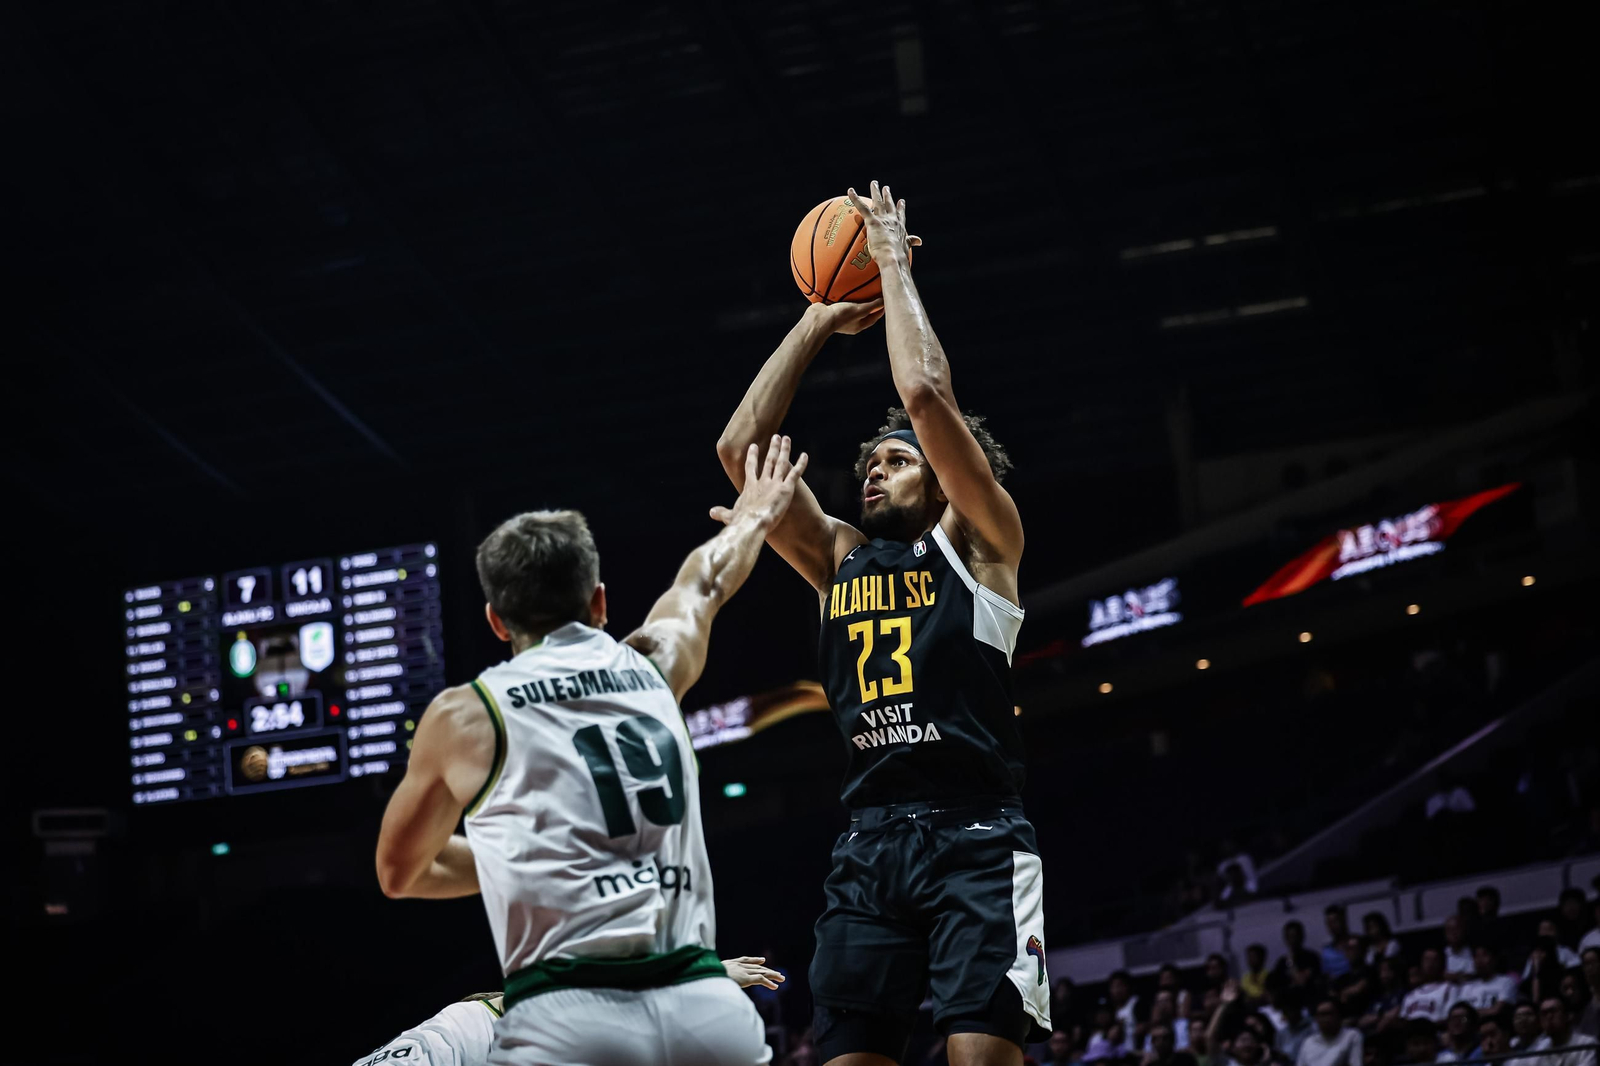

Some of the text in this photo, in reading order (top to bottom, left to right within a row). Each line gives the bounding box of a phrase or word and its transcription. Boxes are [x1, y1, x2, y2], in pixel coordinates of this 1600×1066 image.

[237, 575, 256, 603] 7
[292, 566, 322, 596] 11
[829, 571, 935, 620] ALAHLI SC
[847, 616, 913, 704] 23
[861, 703, 913, 728] VISIT
[852, 722, 942, 751] RWANDA
[572, 716, 686, 839] 19
